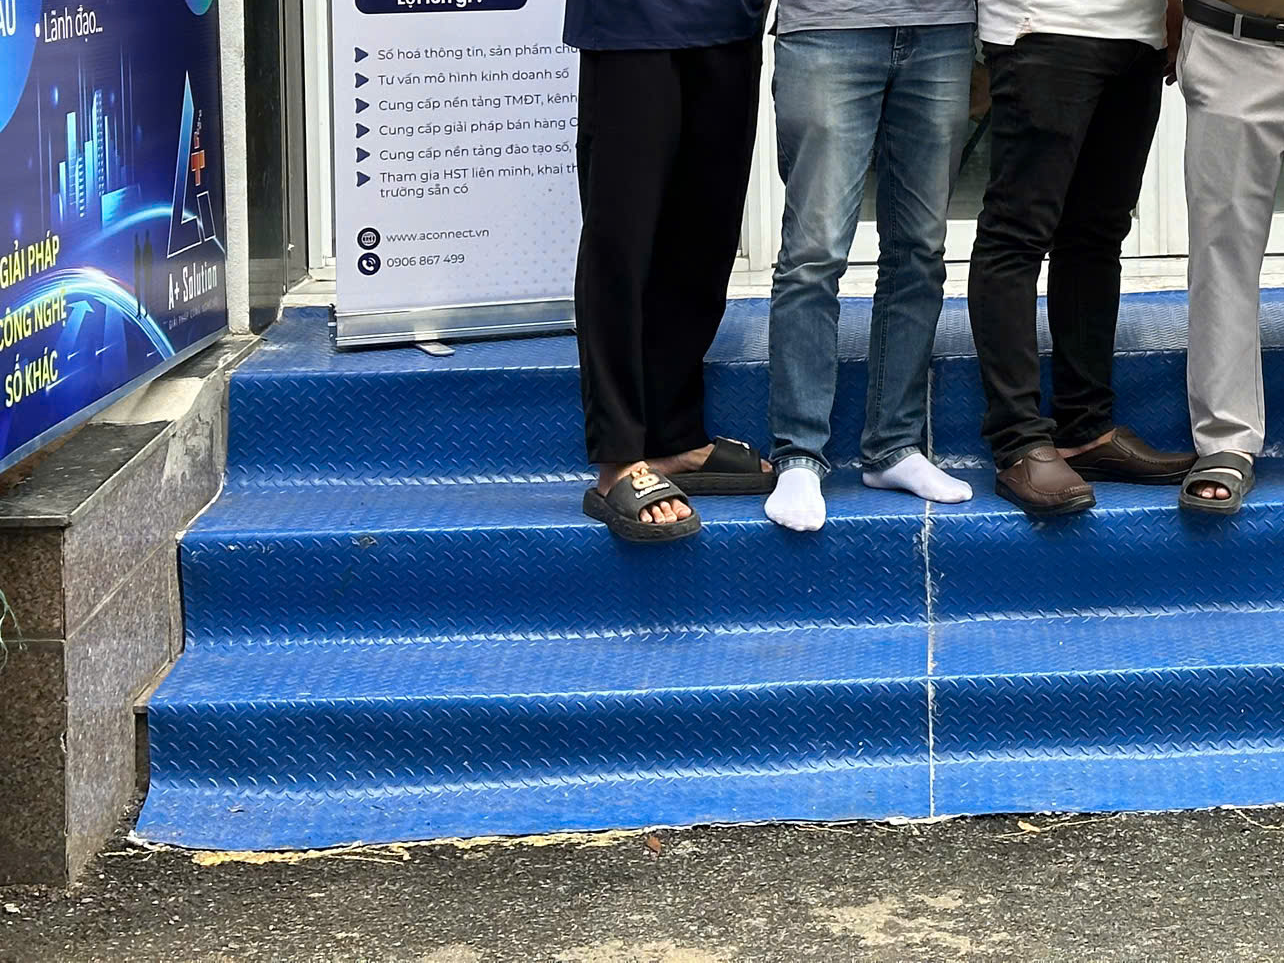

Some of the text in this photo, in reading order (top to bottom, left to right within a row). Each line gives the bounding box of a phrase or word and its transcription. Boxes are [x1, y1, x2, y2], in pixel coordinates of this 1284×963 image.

[43, 7, 72, 43] Lãnh
[378, 48, 394, 60] Số
[397, 48, 421, 59] hoá
[424, 47, 463, 60] thông
[466, 46, 487, 58] tin,
[489, 45, 511, 56] sản
[378, 67, 569, 85] Tư vấn mô hình kinh doanh số
[379, 100, 414, 112] Cung
[417, 97, 440, 110] cấp
[472, 96, 501, 108] tảng
[504, 94, 544, 106] TMĐT,
[547, 93, 578, 104] kênh
[379, 125, 414, 137] Cung
[417, 122, 441, 135] cấp
[444, 121, 467, 135] giải
[471, 121, 503, 133] pháp
[507, 119, 530, 130] bán
[534, 118, 566, 130] hàng
[379, 150, 414, 162] Cung
[418, 147, 441, 160] cấp
[473, 145, 502, 157] tảng
[505, 143, 529, 154] đào
[532, 144, 552, 155] tạo
[555, 141, 572, 153] số,
[380, 172, 416, 183] Tham
[420, 169, 440, 183] gia
[444, 168, 468, 179] HST
[472, 167, 494, 178] liên
[498, 165, 534, 177] minh,
[537, 164, 563, 175] khai
[453, 183, 469, 194] có
[386, 229, 489, 242] www.aconnect.vn
[0, 230, 60, 287] GIẢI PHÁP
[386, 254, 465, 267] 0906 867 499
[169, 261, 217, 310] A+ Solution
[34, 287, 67, 327] NGHỆ
[5, 347, 59, 407] SỐ KHÁC
